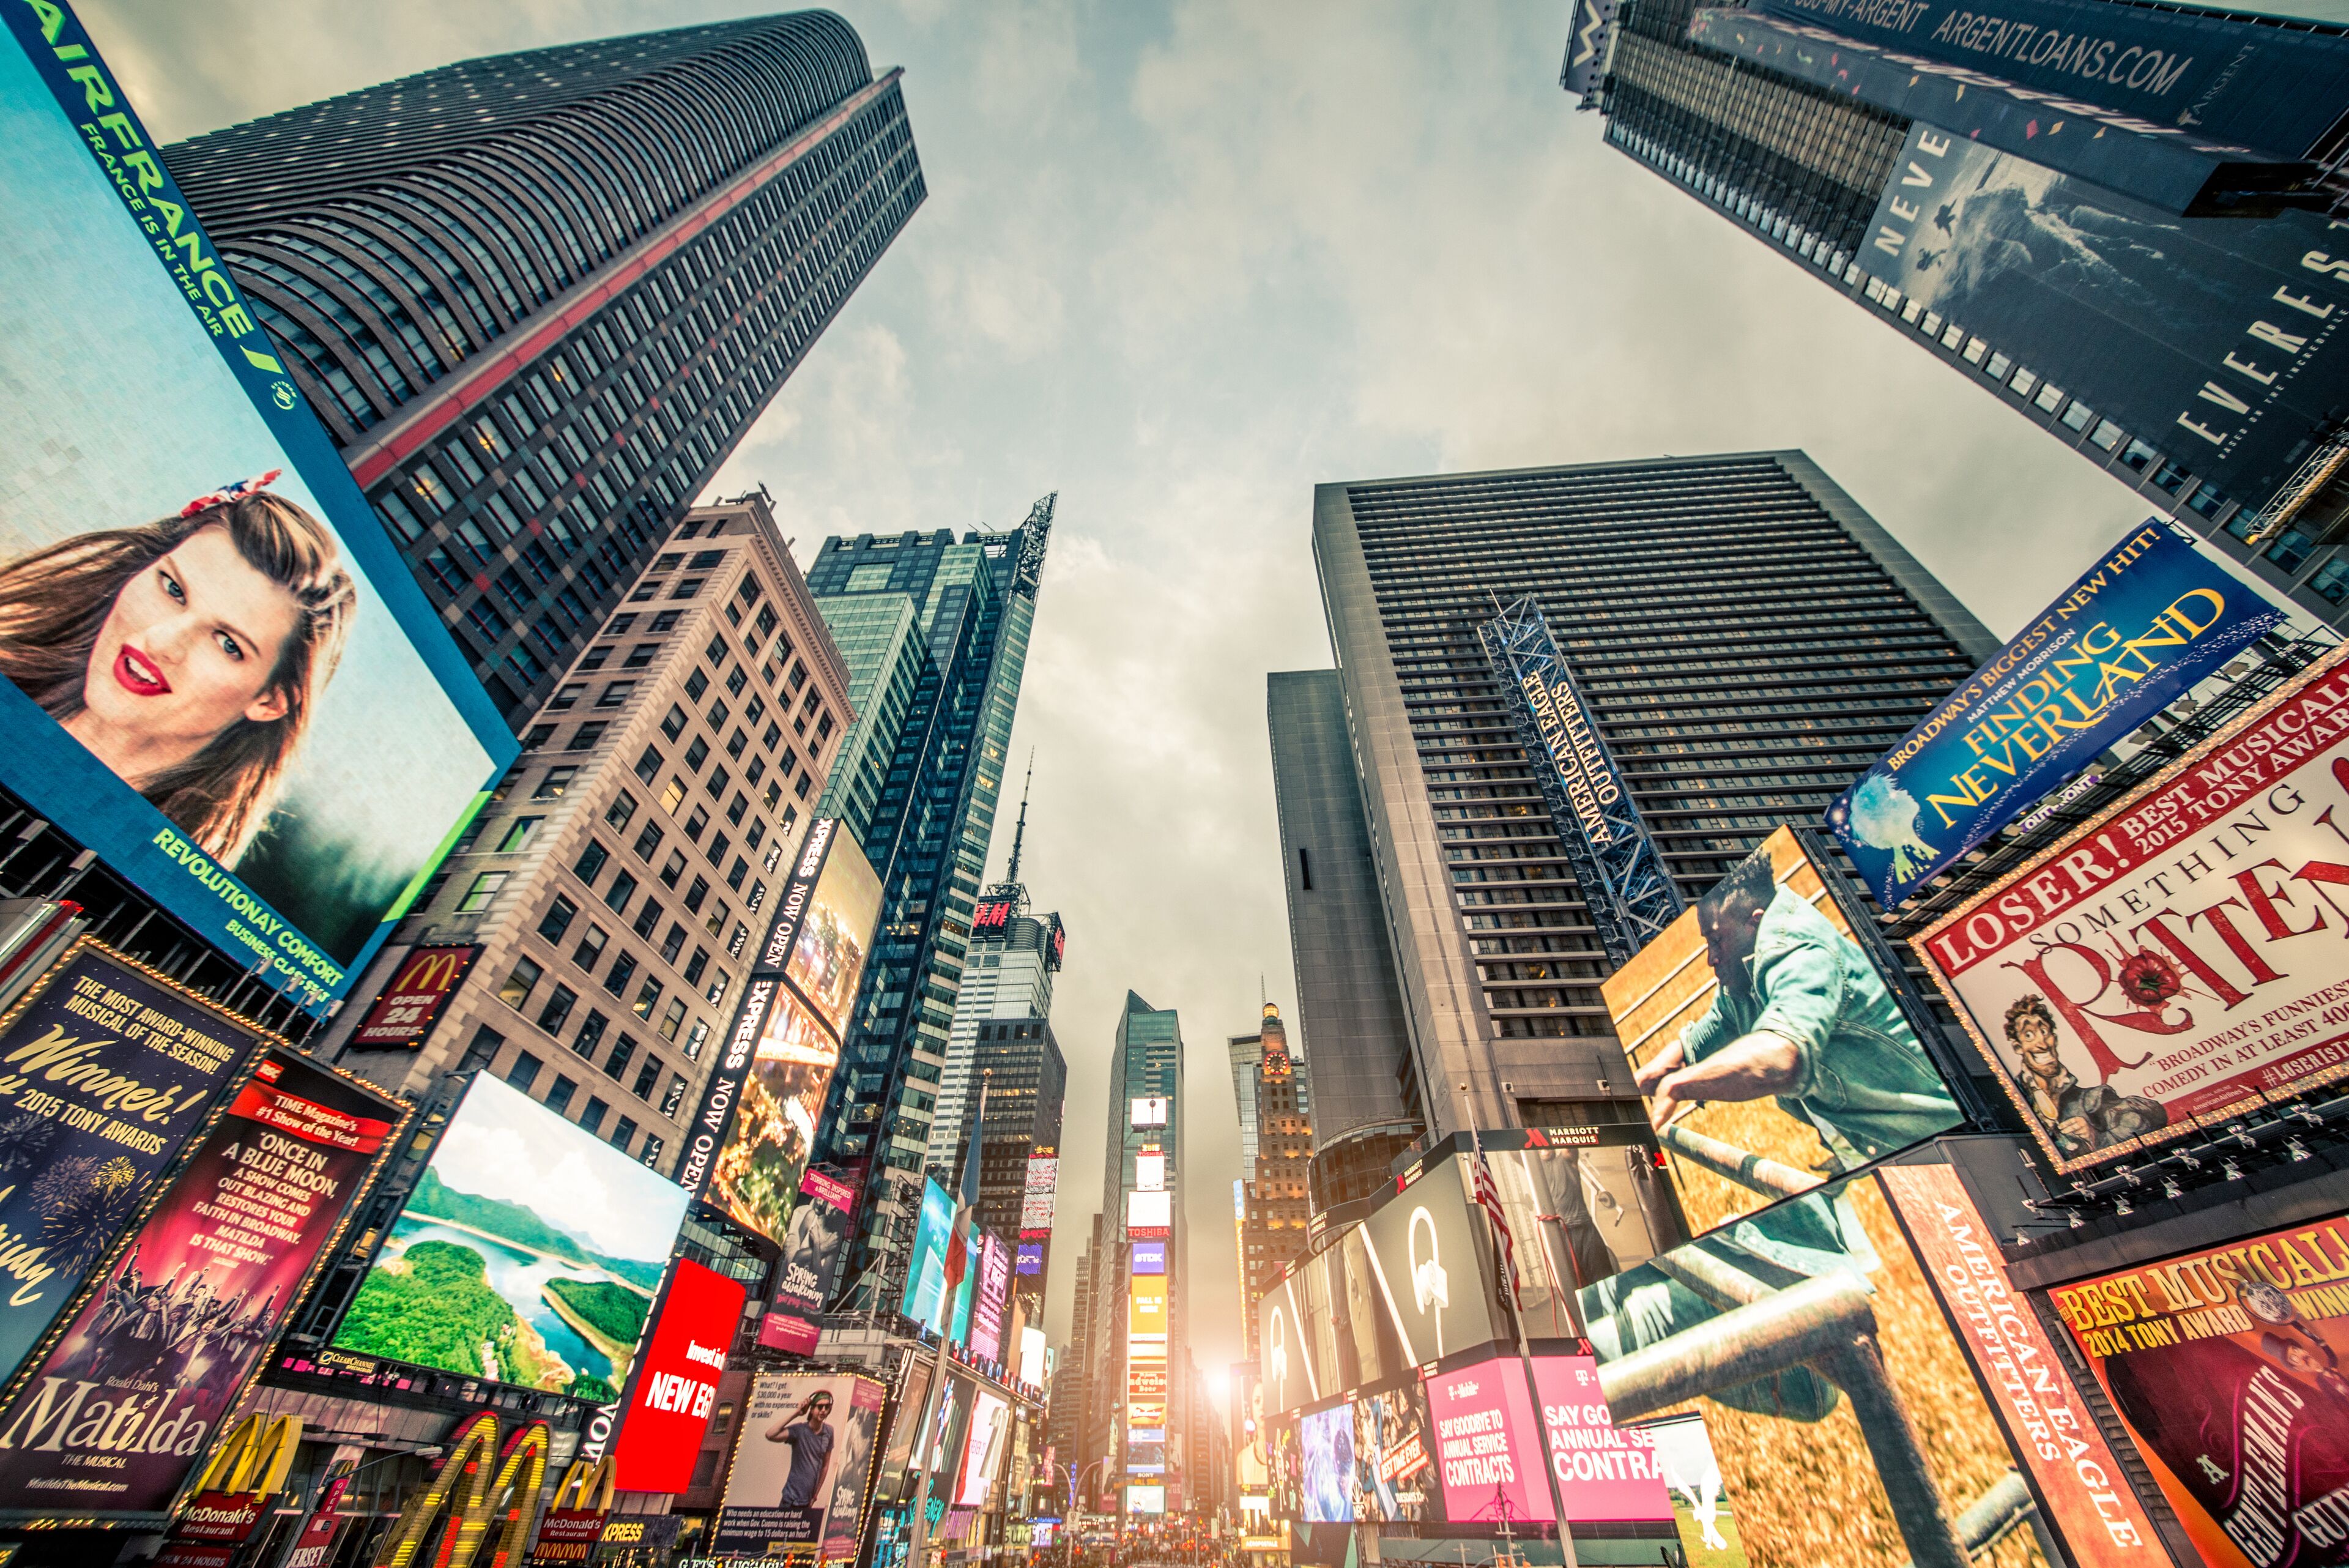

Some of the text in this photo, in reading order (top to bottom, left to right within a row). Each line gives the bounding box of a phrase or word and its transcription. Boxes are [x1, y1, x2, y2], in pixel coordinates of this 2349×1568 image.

[1931, 9, 2193, 97] ARGENTLOANS.COM
[80, 123, 223, 337] FRANCE IS IN THE AIR
[2217, 427, 2248, 459] BASED
[2264, 384, 2285, 404] THE
[1887, 527, 2162, 771] BROADWAY'S BIGGEST NEW HIT!
[1962, 622, 2123, 757] FINDING
[1966, 628, 2077, 723] MATTHEW MORRISON
[1926, 587, 2226, 829] NEVERLAND
[1523, 670, 1612, 844] AMERICAN EAGLE
[1550, 681, 1620, 806] OUTFITTERS
[2118, 782, 2195, 839] BEST
[2134, 763, 2268, 856] 2015 TONY
[2029, 782, 2307, 955] SOMETHING
[153, 828, 344, 987] REVOLUTIONAY COMFORT
[1934, 833, 2126, 972] LOSER!
[764, 882, 809, 968] NOW OPEN
[73, 976, 236, 1062] THE MOST AWARD-WINNING
[380, 1006, 424, 1024] 24
[390, 995, 437, 1006] OPEN
[64, 994, 222, 1076] MUSICAL OF THE SEASON!
[362, 1026, 423, 1037] HOURS
[4, 1024, 209, 1125] Winner!
[2142, 1019, 2320, 1099] COMEDY IN AT LEAST
[14, 1088, 169, 1156] 2015 TONY AWARDS
[275, 1094, 358, 1132] TIME Magazine's
[703, 1077, 737, 1133] NOW
[255, 1105, 360, 1147] #1 Show of the Year!
[1549, 1126, 1600, 1136] MARRIOTT
[1551, 1134, 1597, 1145] MARQUIS
[221, 1142, 339, 1200] A BLUE MOON,
[305, 1151, 329, 1172] IN
[218, 1177, 311, 1217] OUT BLAZING AND
[233, 1167, 313, 1203] A SHOW COMES
[191, 1201, 302, 1245] FAITH IN BROADWAY.
[215, 1192, 298, 1228] RESTORES YOUR
[189, 1233, 237, 1255] IS THAT
[214, 1224, 266, 1249] MATILDA
[1129, 1227, 1170, 1236] TOSHIBA
[786, 1262, 818, 1288] SPRING
[1141, 1253, 1163, 1263] TDK
[782, 1280, 825, 1308] awakening
[2057, 1273, 2154, 1331] BEST
[2083, 1304, 2255, 1359] 2014 TONY AWARD
[1933, 1200, 2143, 1549] AMERICAN EAGLE
[1945, 1263, 2063, 1462] OUTFITTERS
[105, 1375, 160, 1392] Roald Dahl's
[645, 1371, 698, 1414] NEW
[0, 1377, 207, 1456] Matilda
[1439, 1409, 1504, 1439] SAY GOODBYE TO
[1545, 1406, 1579, 1427] SAY
[1443, 1438, 1473, 1459] ANNUAL
[1472, 1432, 1508, 1455] SERVICE
[1551, 1429, 1627, 1449] ANNUAL
[61, 1452, 127, 1469] THE MUSICAL
[1445, 1454, 1515, 1487] CONTRACTS
[2196, 1454, 2230, 1485] A
[2223, 1364, 2305, 1568] GENTLEMAN'S
[25, 1477, 129, 1492] MatildaTheMusical.com
[325, 1482, 343, 1513] OPEN
[181, 1506, 256, 1525] McDonald's
[181, 1523, 236, 1536] Restaurant
[543, 1518, 601, 1529] McDonald's
[1353, 1504, 1365, 1519] NBC
[550, 1529, 588, 1538] Restaurant
[195, 1556, 227, 1567] HOURS
